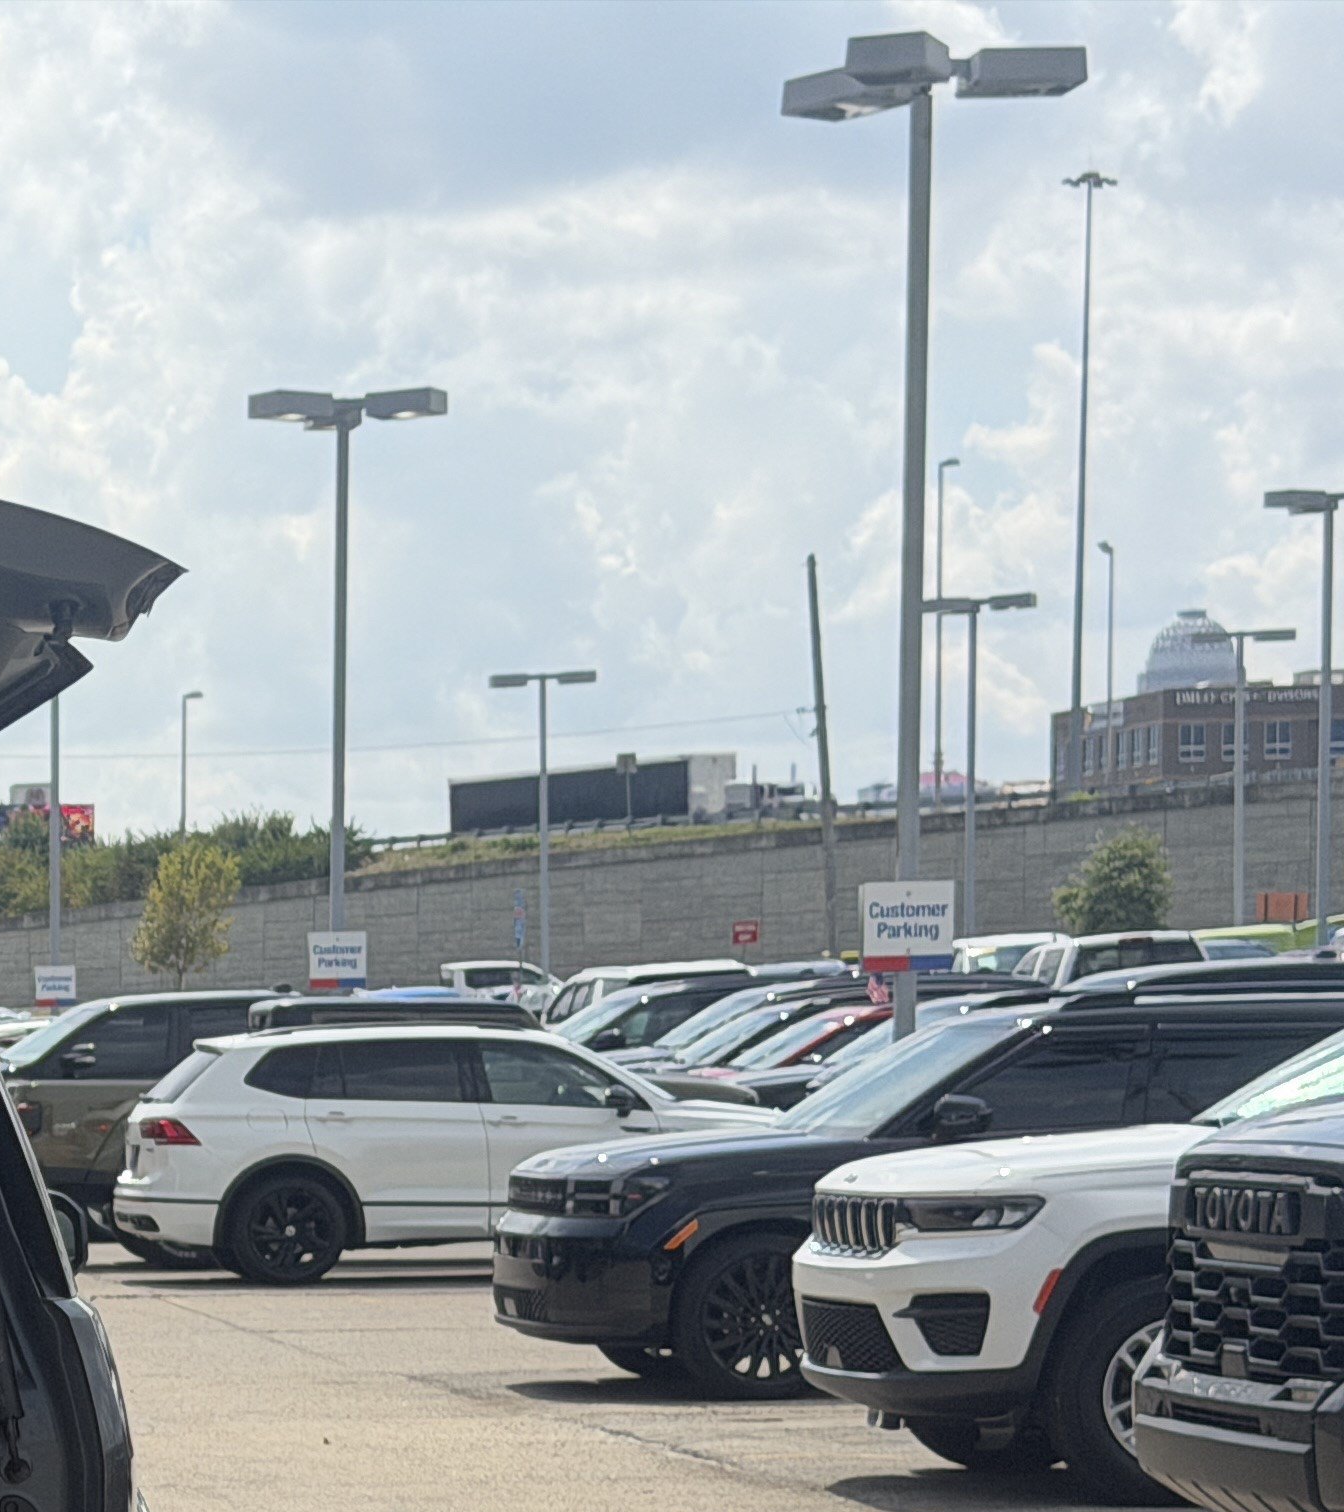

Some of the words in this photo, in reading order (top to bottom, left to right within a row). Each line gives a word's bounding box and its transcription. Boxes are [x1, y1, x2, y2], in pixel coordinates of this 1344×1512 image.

[868, 901, 949, 919] Customer
[876, 921, 940, 941] Parking
[312, 944, 362, 956] Customer
[317, 957, 358, 969] Parking
[1194, 1186, 1293, 1236] TOYOTA
